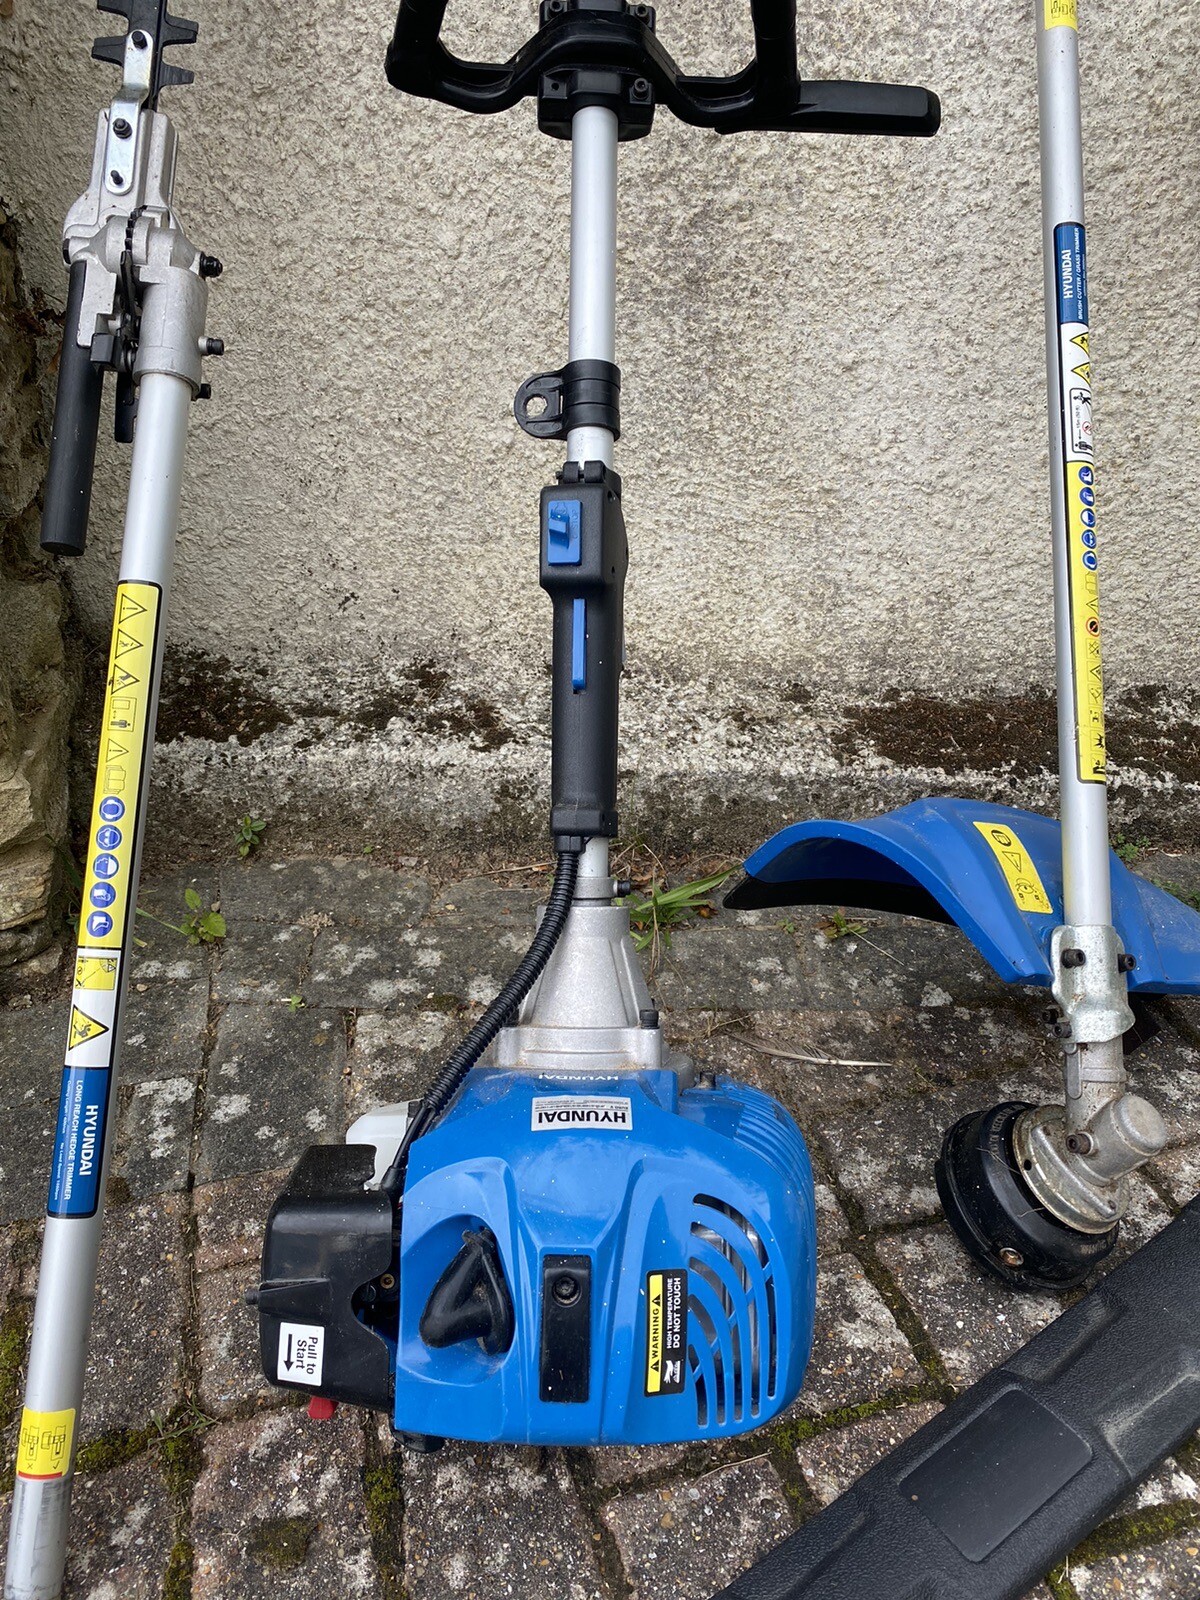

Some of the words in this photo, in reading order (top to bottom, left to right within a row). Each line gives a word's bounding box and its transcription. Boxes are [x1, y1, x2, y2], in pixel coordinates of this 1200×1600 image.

[1061, 249, 1074, 299] HYUNDAI
[1075, 277, 1083, 299] CUTTER
[74, 1079, 84, 1103] LONG
[71, 1103, 81, 1131] REACH
[538, 1110, 626, 1124] HYUNDAI
[68, 1132, 77, 1160] HEDGE
[79, 1104, 99, 1176] HYUNDAI
[64, 1161, 75, 1200] TRIMMER
[673, 1277, 681, 1310] TOUCH
[651, 1308, 660, 1359] WARNING
[673, 1310, 681, 1332] NOT
[295, 1339, 307, 1370] Start
[307, 1336, 319, 1360] Pull
[672, 1334, 680, 1348] DO
[306, 1363, 316, 1375] to
